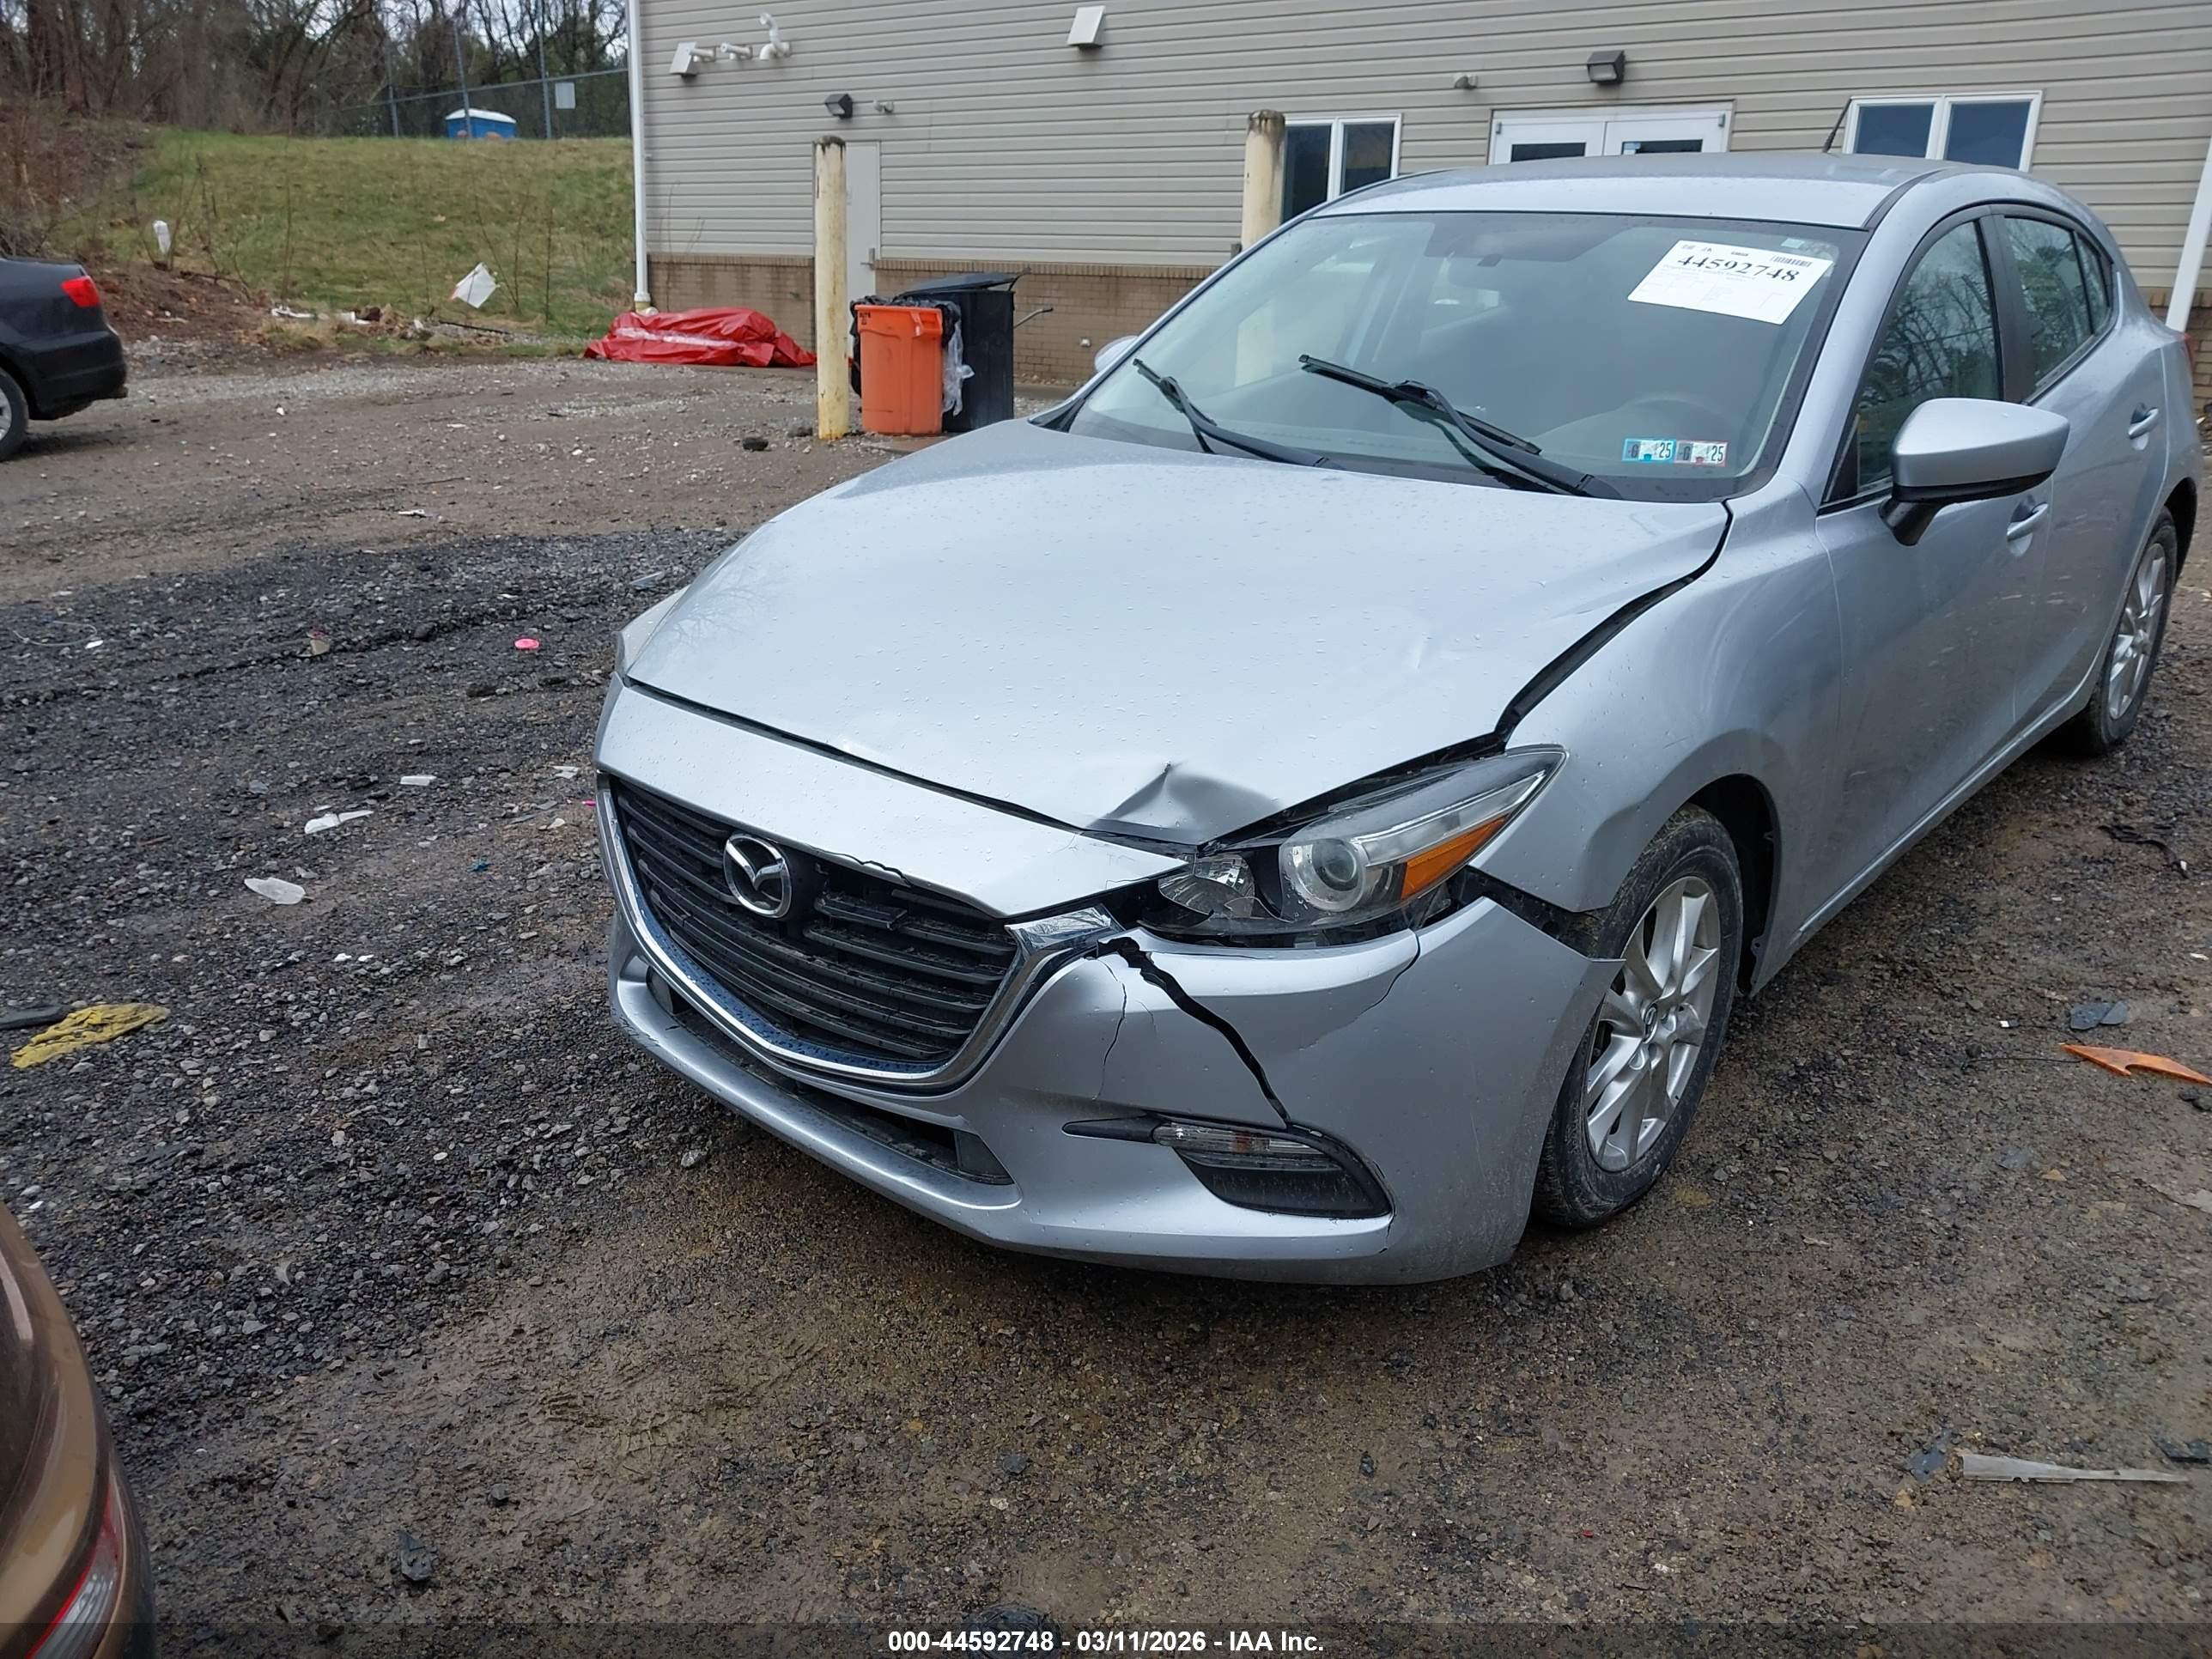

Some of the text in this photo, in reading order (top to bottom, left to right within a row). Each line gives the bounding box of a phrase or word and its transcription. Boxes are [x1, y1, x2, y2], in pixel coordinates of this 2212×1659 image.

[1677, 254, 1801, 282] 44592748
[1658, 441, 1672, 459] 25
[1711, 445, 1724, 462] 25
